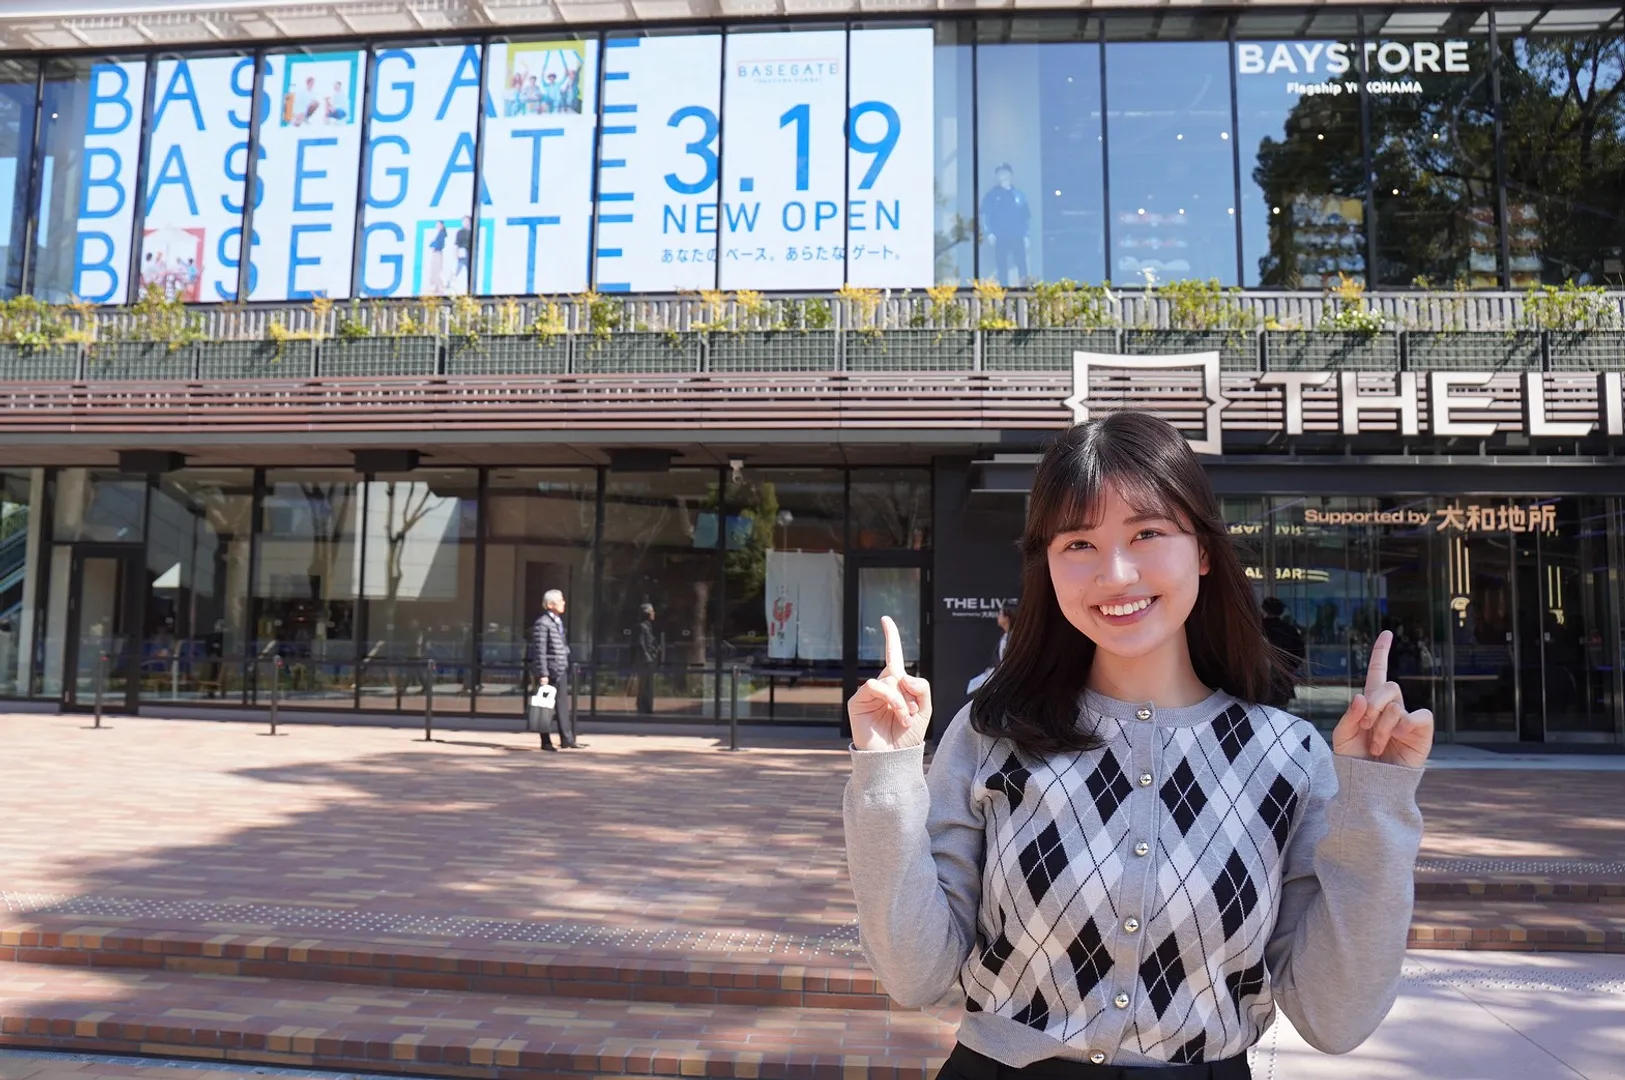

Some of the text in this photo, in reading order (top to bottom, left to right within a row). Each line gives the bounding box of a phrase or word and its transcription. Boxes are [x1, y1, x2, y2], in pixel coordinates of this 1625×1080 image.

[738, 63, 838, 77] BASEGATE
[1239, 42, 1470, 74] BAYSTORE
[1287, 81, 1343, 96] Flagship
[663, 101, 901, 194] 3.19
[78, 126, 637, 219] BASEGATE
[663, 200, 900, 234] NEW OPEN
[1258, 371, 1499, 436] THE
[1304, 505, 1556, 532] Supported by 大和地所
[943, 597, 978, 609] THE
